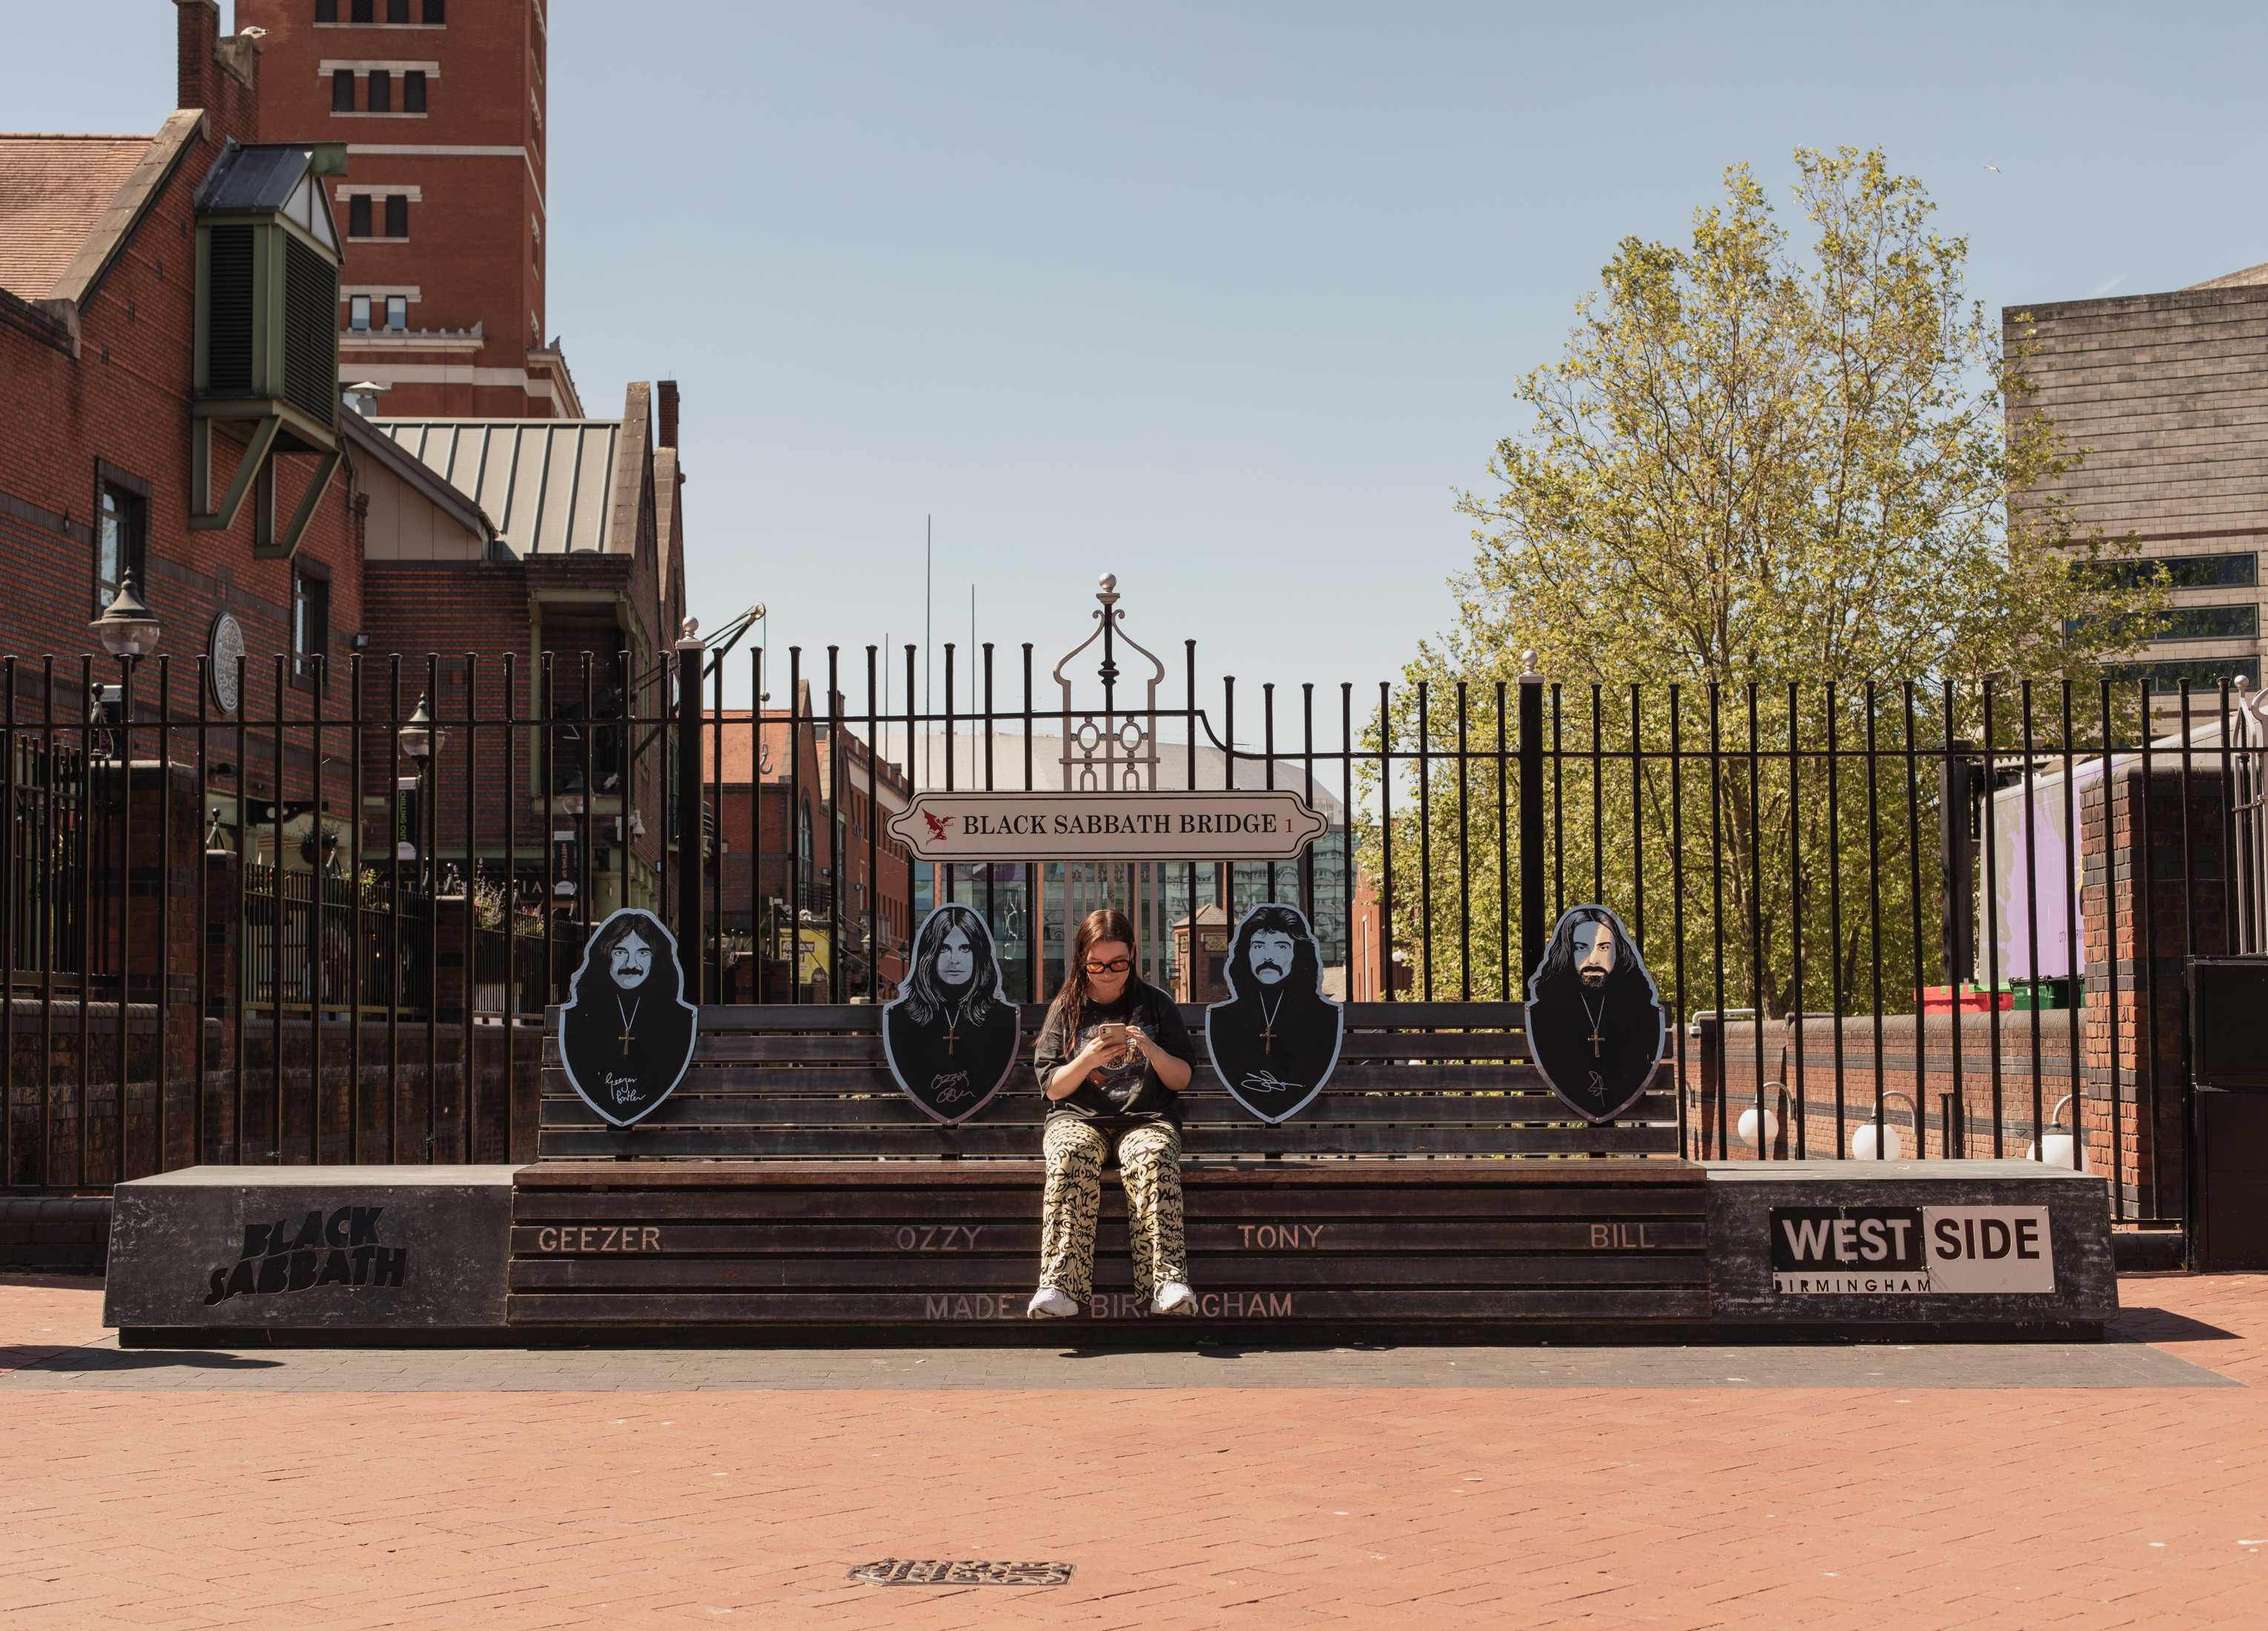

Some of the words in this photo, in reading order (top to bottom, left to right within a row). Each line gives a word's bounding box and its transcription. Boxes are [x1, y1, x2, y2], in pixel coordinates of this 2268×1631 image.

[962, 815, 1048, 835] BLACK
[1054, 814, 1171, 835] SABBATH
[1179, 813, 1277, 834] BRIDGE
[1286, 818, 1294, 833] 1
[561, 870, 567, 879] UP
[240, 1205, 385, 1262] BLACK
[538, 1227, 661, 1251] GEEZER
[896, 1226, 983, 1251] OZZY
[1237, 1225, 1324, 1249] TONY
[1590, 1224, 1656, 1248] BILL
[1782, 1219, 1911, 1261] WEST
[1934, 1218, 2040, 1260] SIDE
[203, 1245, 407, 1308] SABBATH
[1774, 1279, 1931, 1292] BIRMINGHAM
[926, 1294, 1016, 1320] MADE
[1091, 1293, 1292, 1318] BIRGHAM
